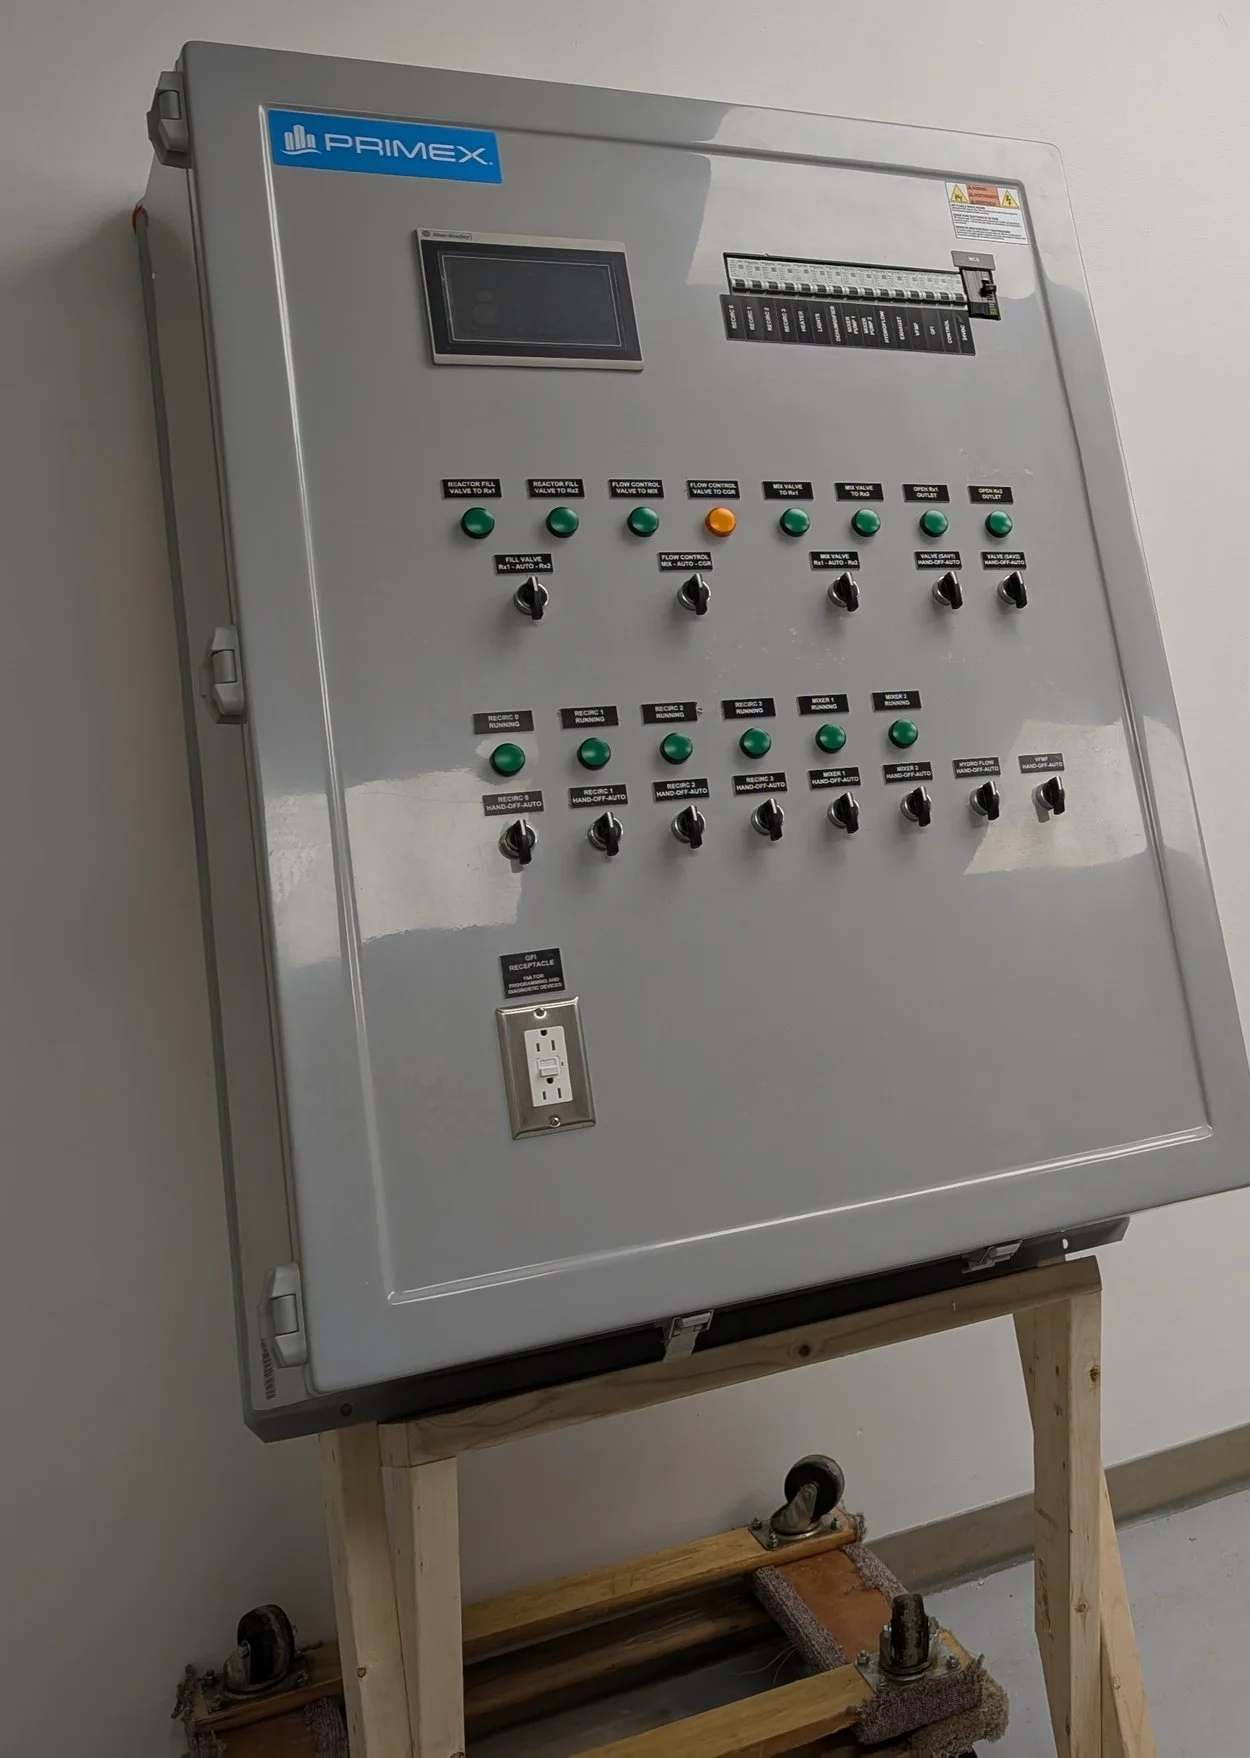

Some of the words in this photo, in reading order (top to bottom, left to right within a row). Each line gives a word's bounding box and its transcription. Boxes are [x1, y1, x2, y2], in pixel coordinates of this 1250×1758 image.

[324, 133, 489, 165] PRIMEX
[729, 309, 738, 329] RECIRC
[747, 310, 755, 331] RECIRC
[764, 311, 773, 331] RECIRC
[782, 312, 790, 333] RECIRC
[798, 311, 807, 332] HEATER
[815, 313, 823, 332] LIGHTS
[830, 305, 841, 342] DEHUMIDIFIER
[896, 316, 905, 340] EXHAUST
[944, 320, 953, 344] CONTROL
[884, 699, 910, 707] RUNNING
[575, 716, 605, 724] RUNNING
[656, 711, 685, 719] RUNNING
[886, 771, 932, 779] HAND-OFF-AUTO
[956, 766, 999, 774] HAND-OFF-AUTO
[812, 776, 859, 785] HAND-OFF-AUTO
[736, 781, 786, 791] HAND-OFF-AUTO
[656, 788, 708, 797] HAND-OFF-AUTO
[572, 794, 626, 804] HAND-OFF-AUTO
[486, 801, 542, 811] HAND-OFF-AUTO
[509, 959, 555, 971] RECEPTACLE
[508, 979, 548, 988] PROGRAMMING
[508, 985, 540, 994] DIAGNOSTIC
